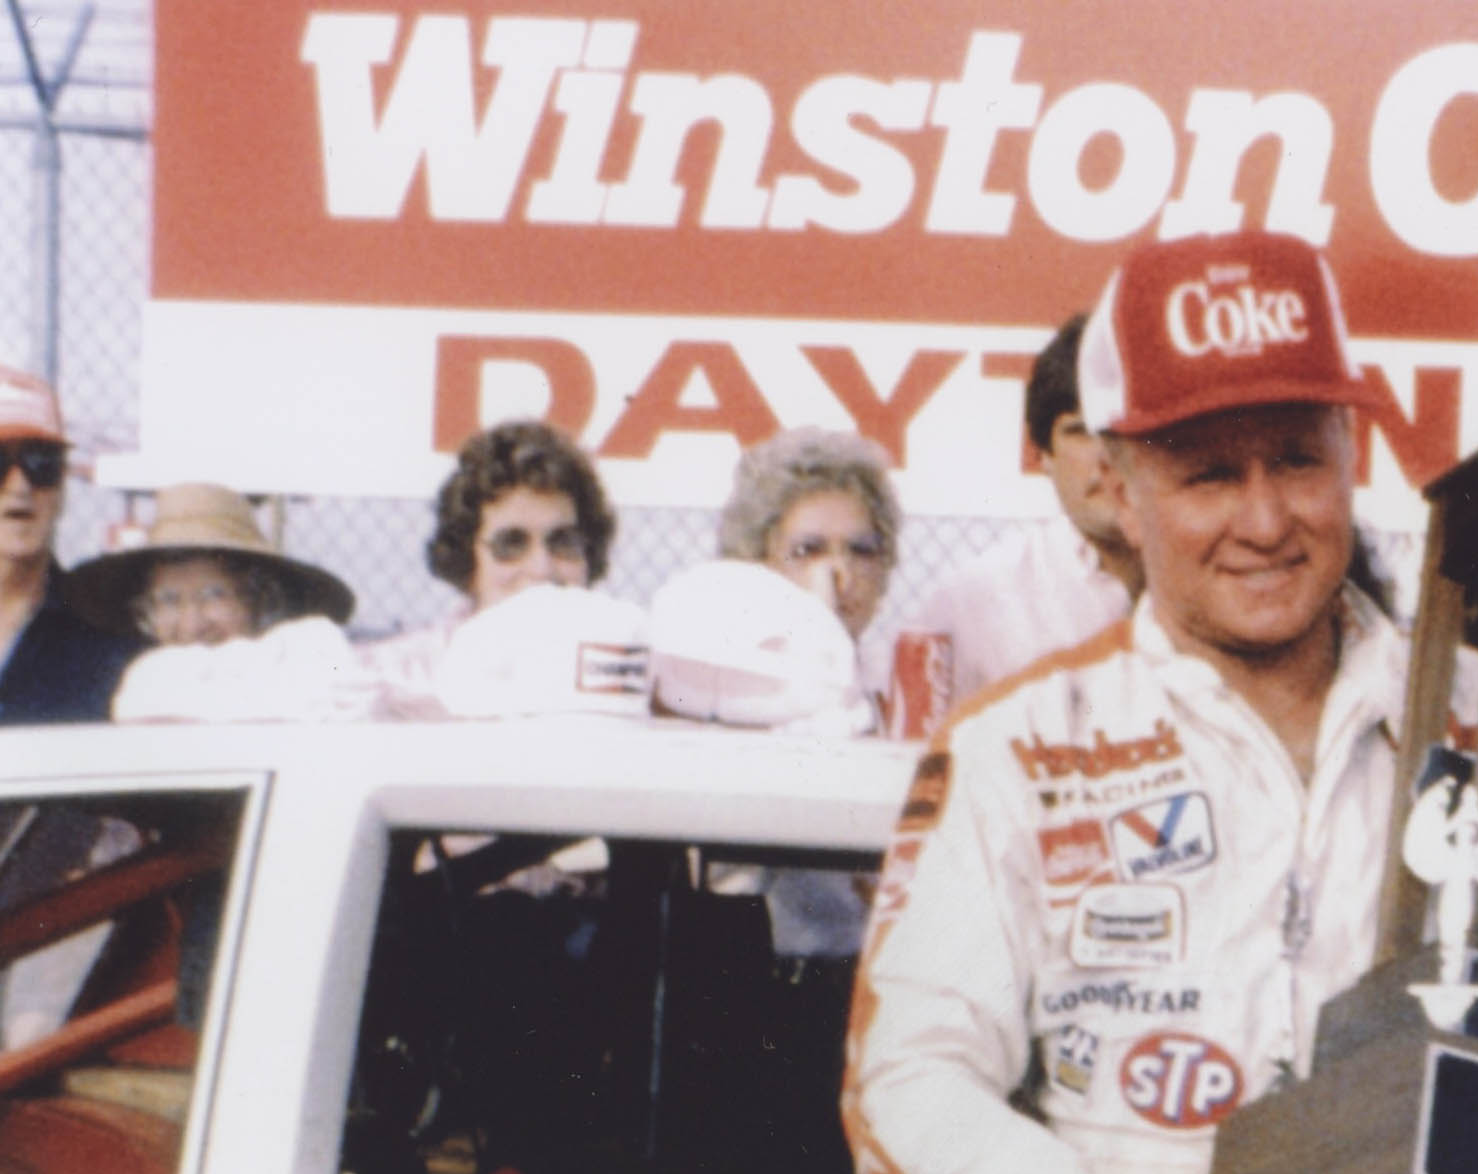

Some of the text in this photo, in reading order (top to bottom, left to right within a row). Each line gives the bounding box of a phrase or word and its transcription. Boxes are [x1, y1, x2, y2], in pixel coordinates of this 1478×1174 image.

[300, 12, 1335, 245] Winston
[1166, 279, 1309, 357] Coke
[1126, 1040, 1236, 1123] STP
